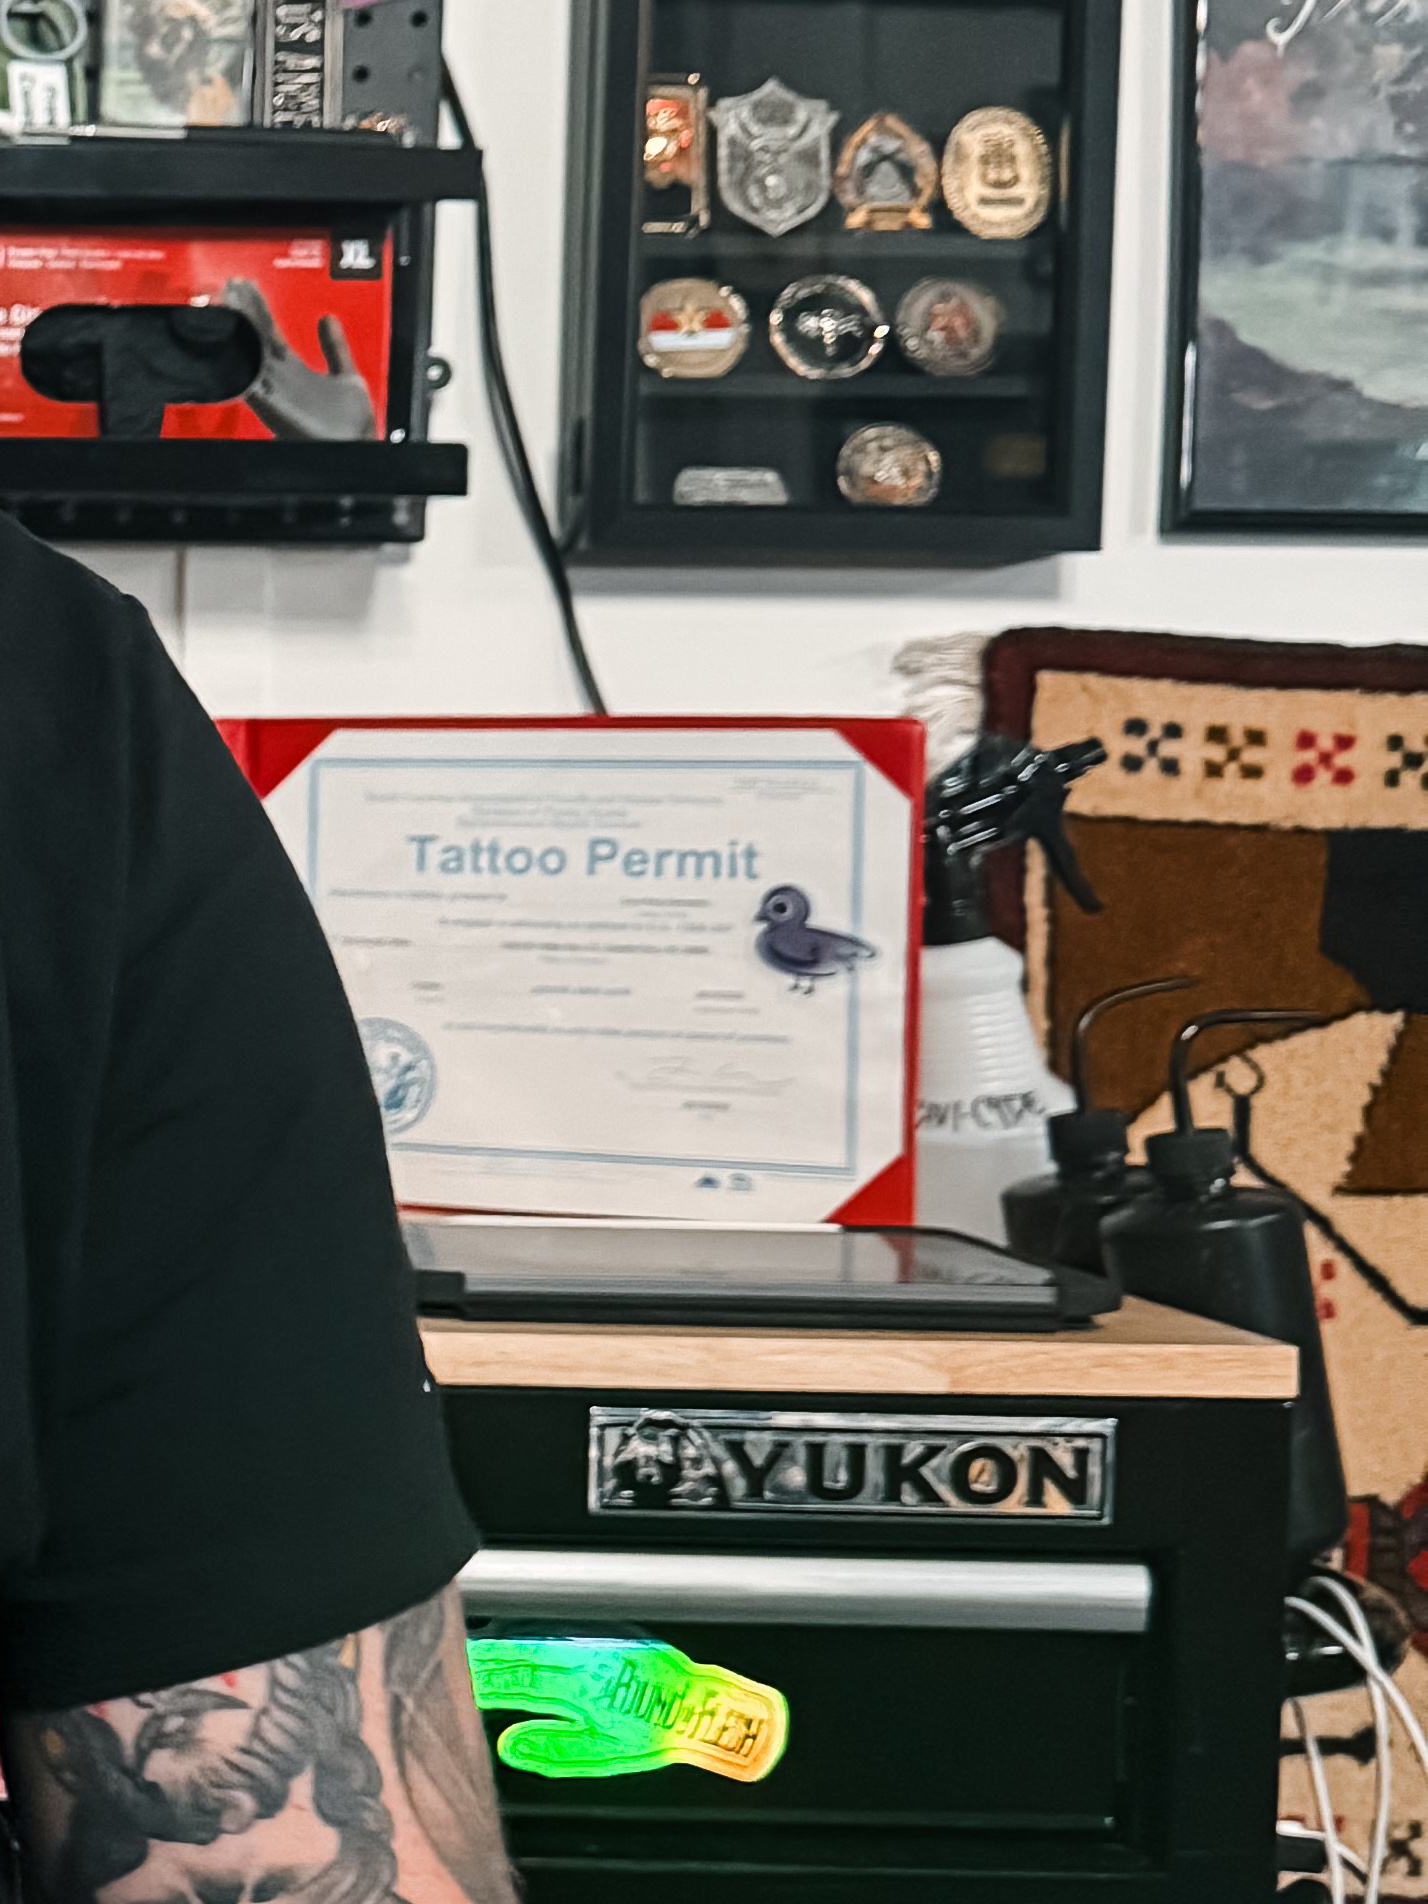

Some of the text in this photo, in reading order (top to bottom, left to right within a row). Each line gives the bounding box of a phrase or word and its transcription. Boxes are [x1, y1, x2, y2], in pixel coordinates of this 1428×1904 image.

[406, 834, 760, 881] Tattoo Permit
[724, 1435, 1092, 1508] YUKON
